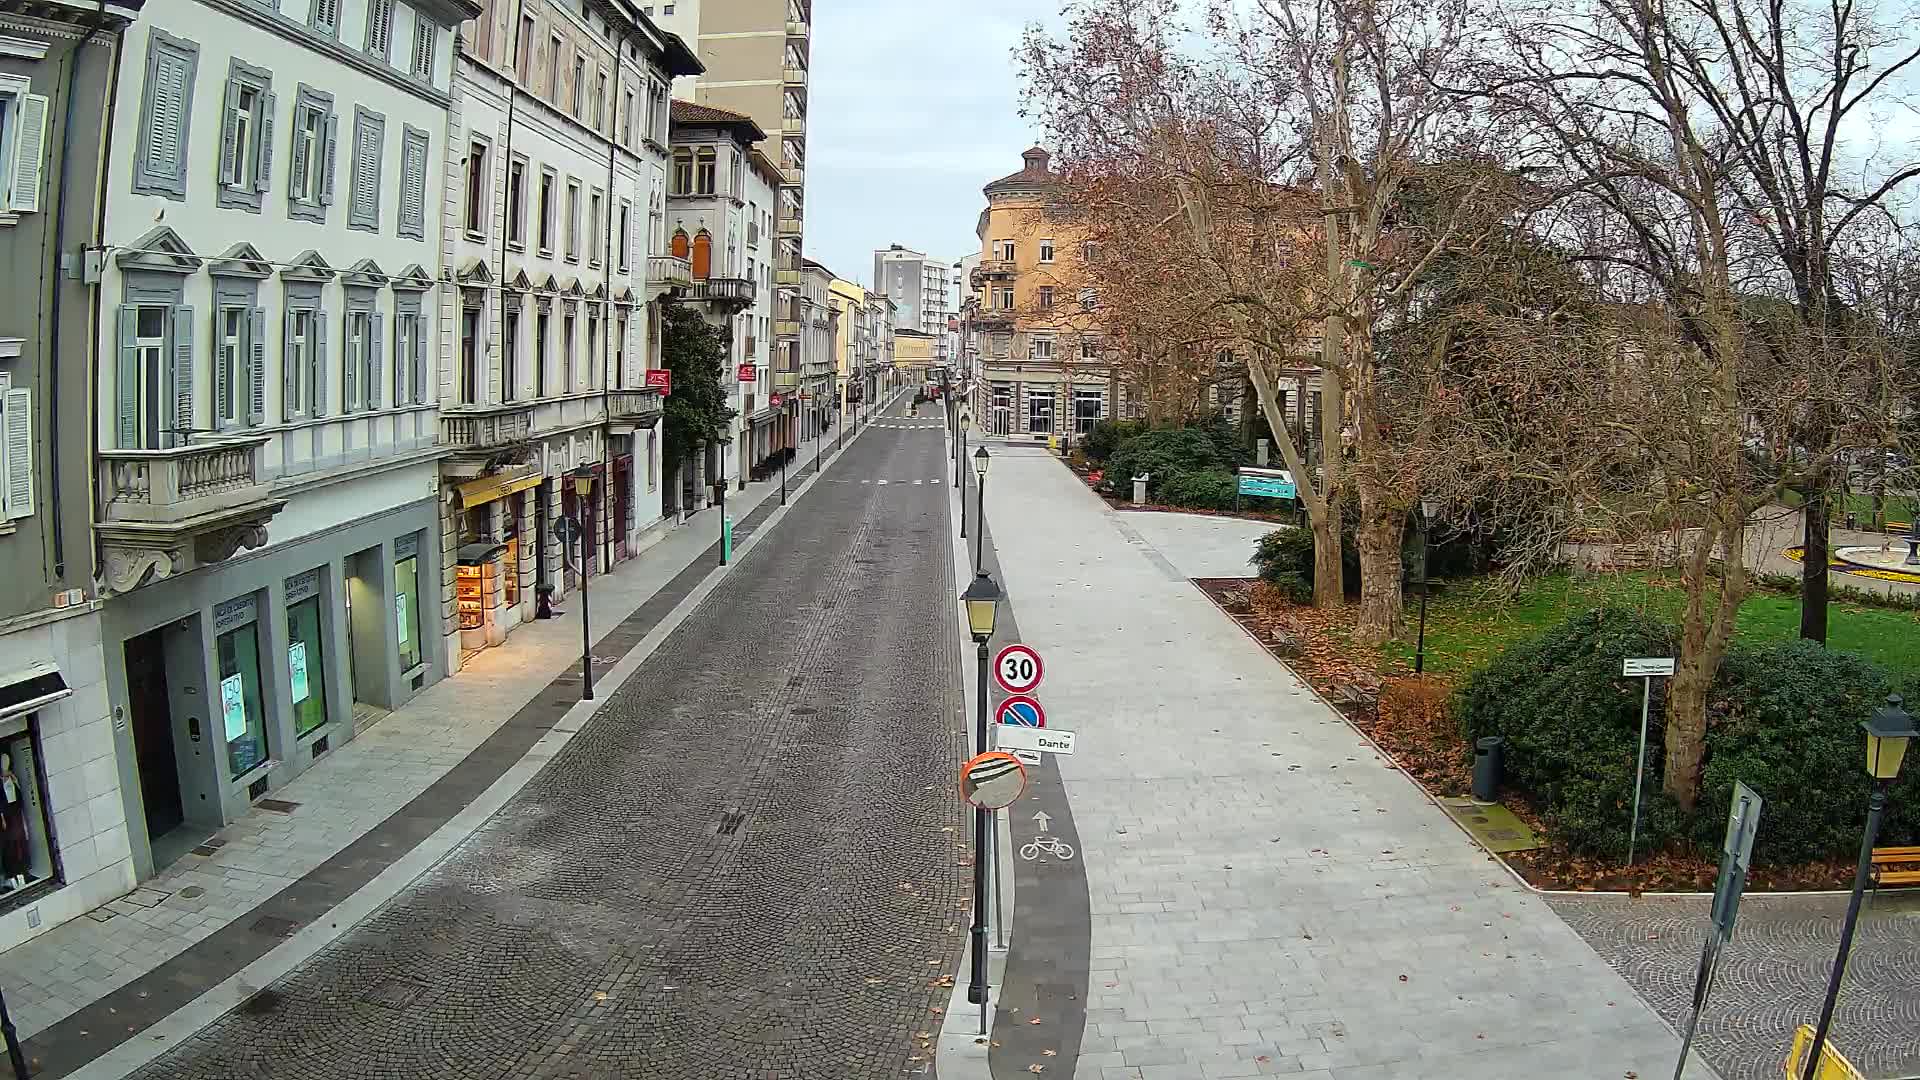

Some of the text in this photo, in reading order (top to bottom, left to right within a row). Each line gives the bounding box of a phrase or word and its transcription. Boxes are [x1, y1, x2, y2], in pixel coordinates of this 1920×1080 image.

[215, 611, 244, 628] OPERATIVO
[1006, 659, 1033, 680] 30
[1038, 738, 1070, 749] Dante
